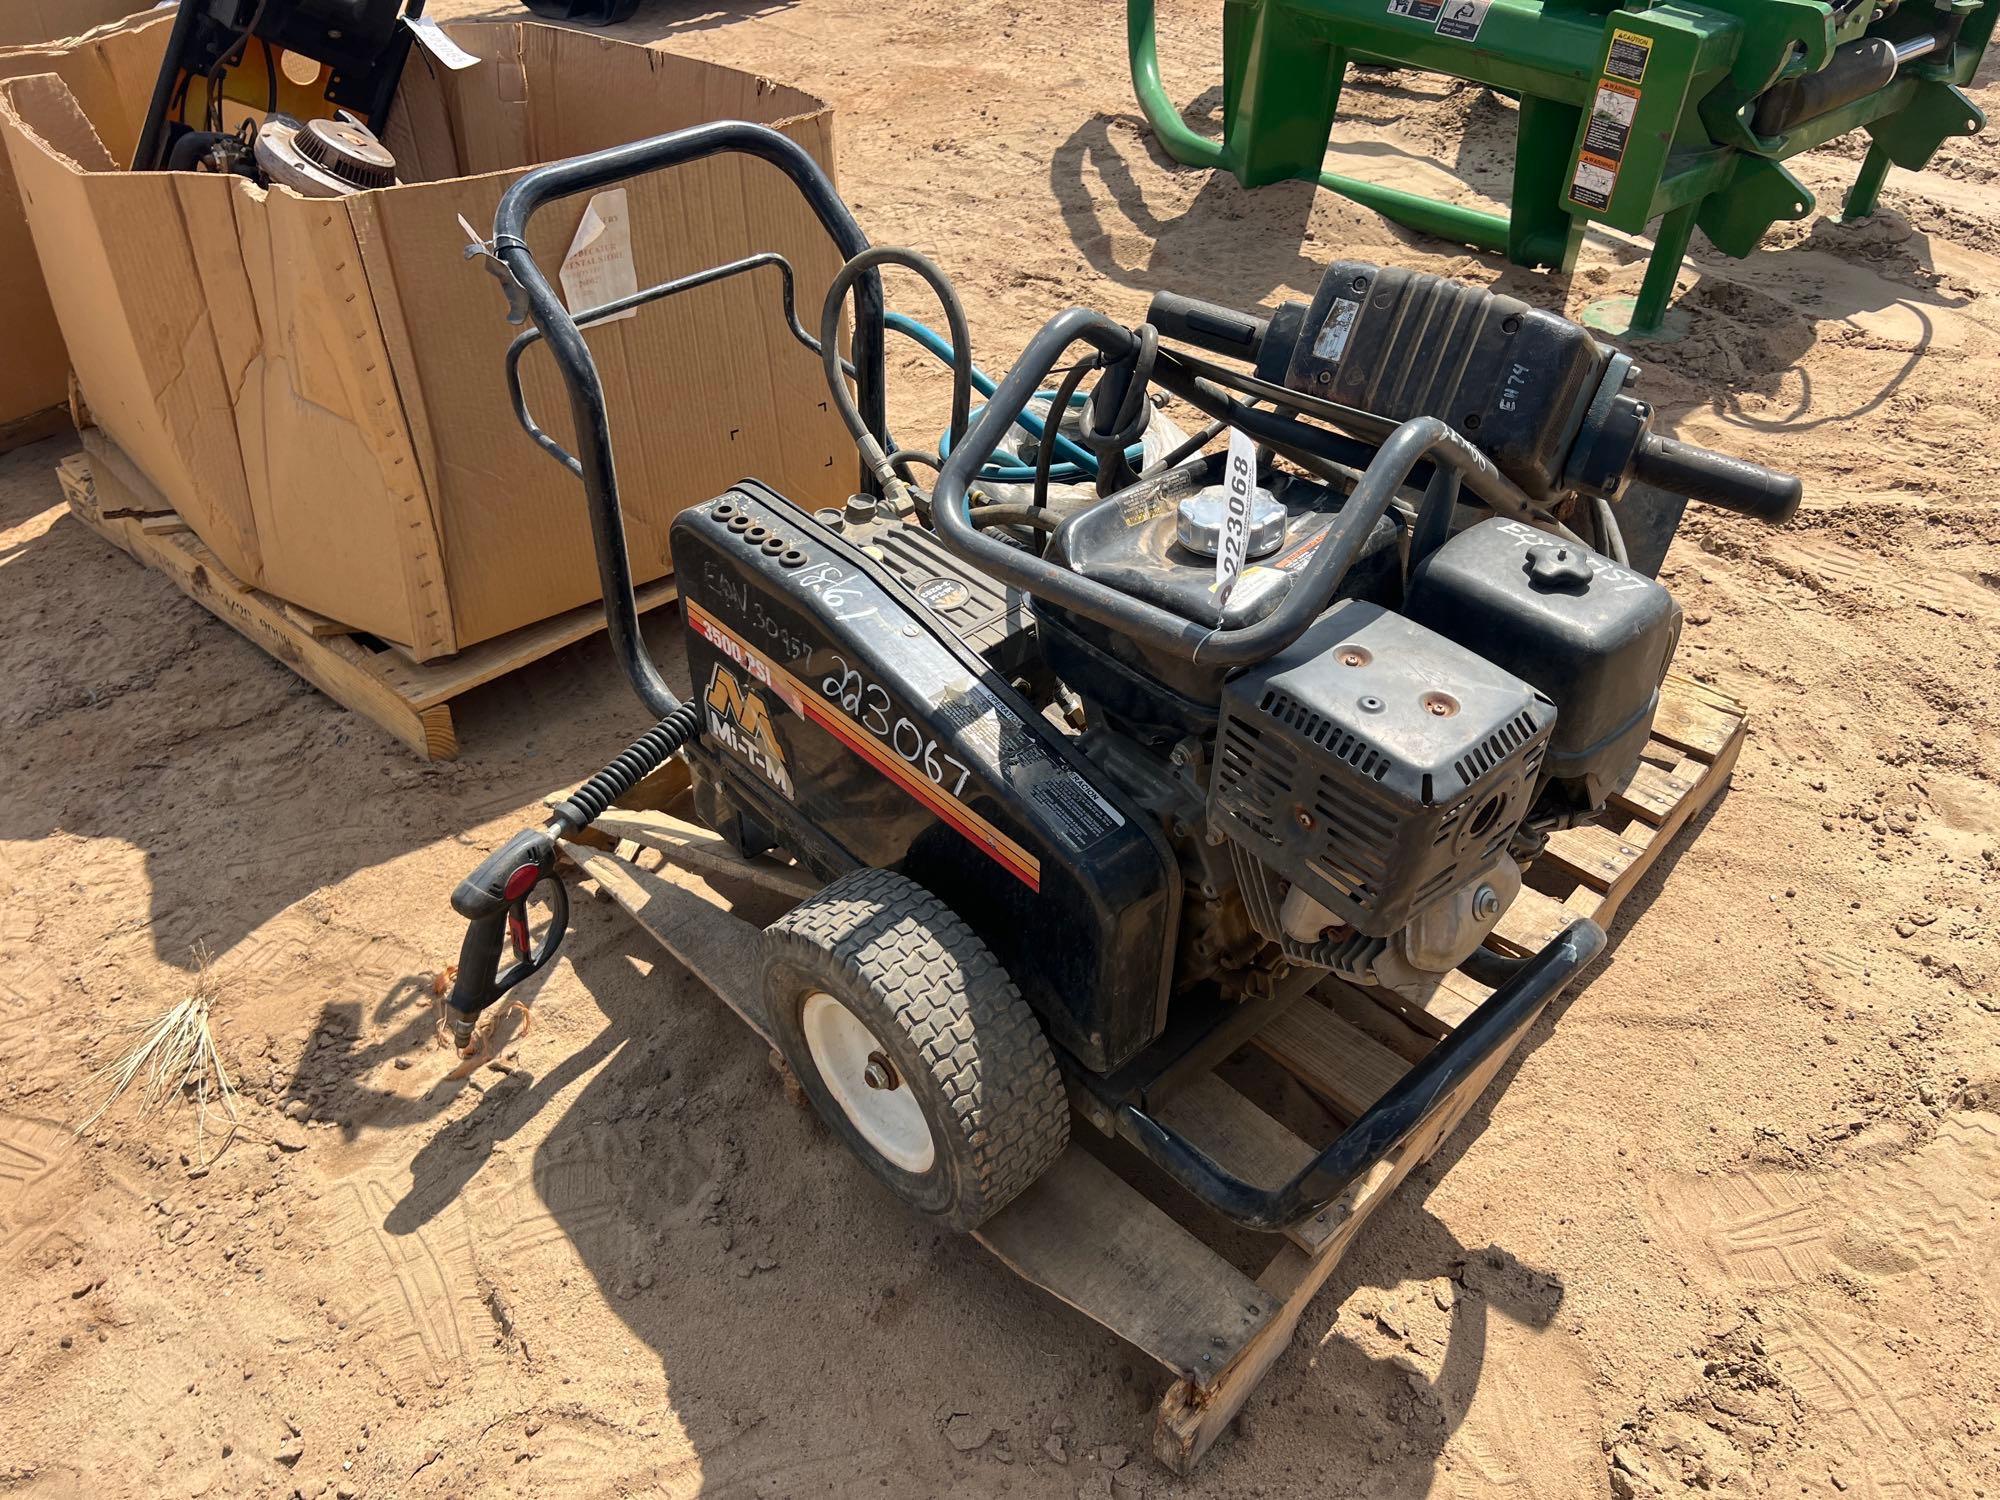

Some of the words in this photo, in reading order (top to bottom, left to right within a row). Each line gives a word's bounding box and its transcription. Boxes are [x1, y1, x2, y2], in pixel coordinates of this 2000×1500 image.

[1623, 33, 1649, 46] CAUTION
[1608, 84, 1636, 97] WARNING
[1588, 157, 1615, 171] WARNING
[1223, 455, 1249, 577] 223068
[702, 619, 743, 664] 3500
[744, 650, 773, 687] PSI
[710, 710, 789, 793] Mi-T-M
[822, 655, 971, 798] 223067
